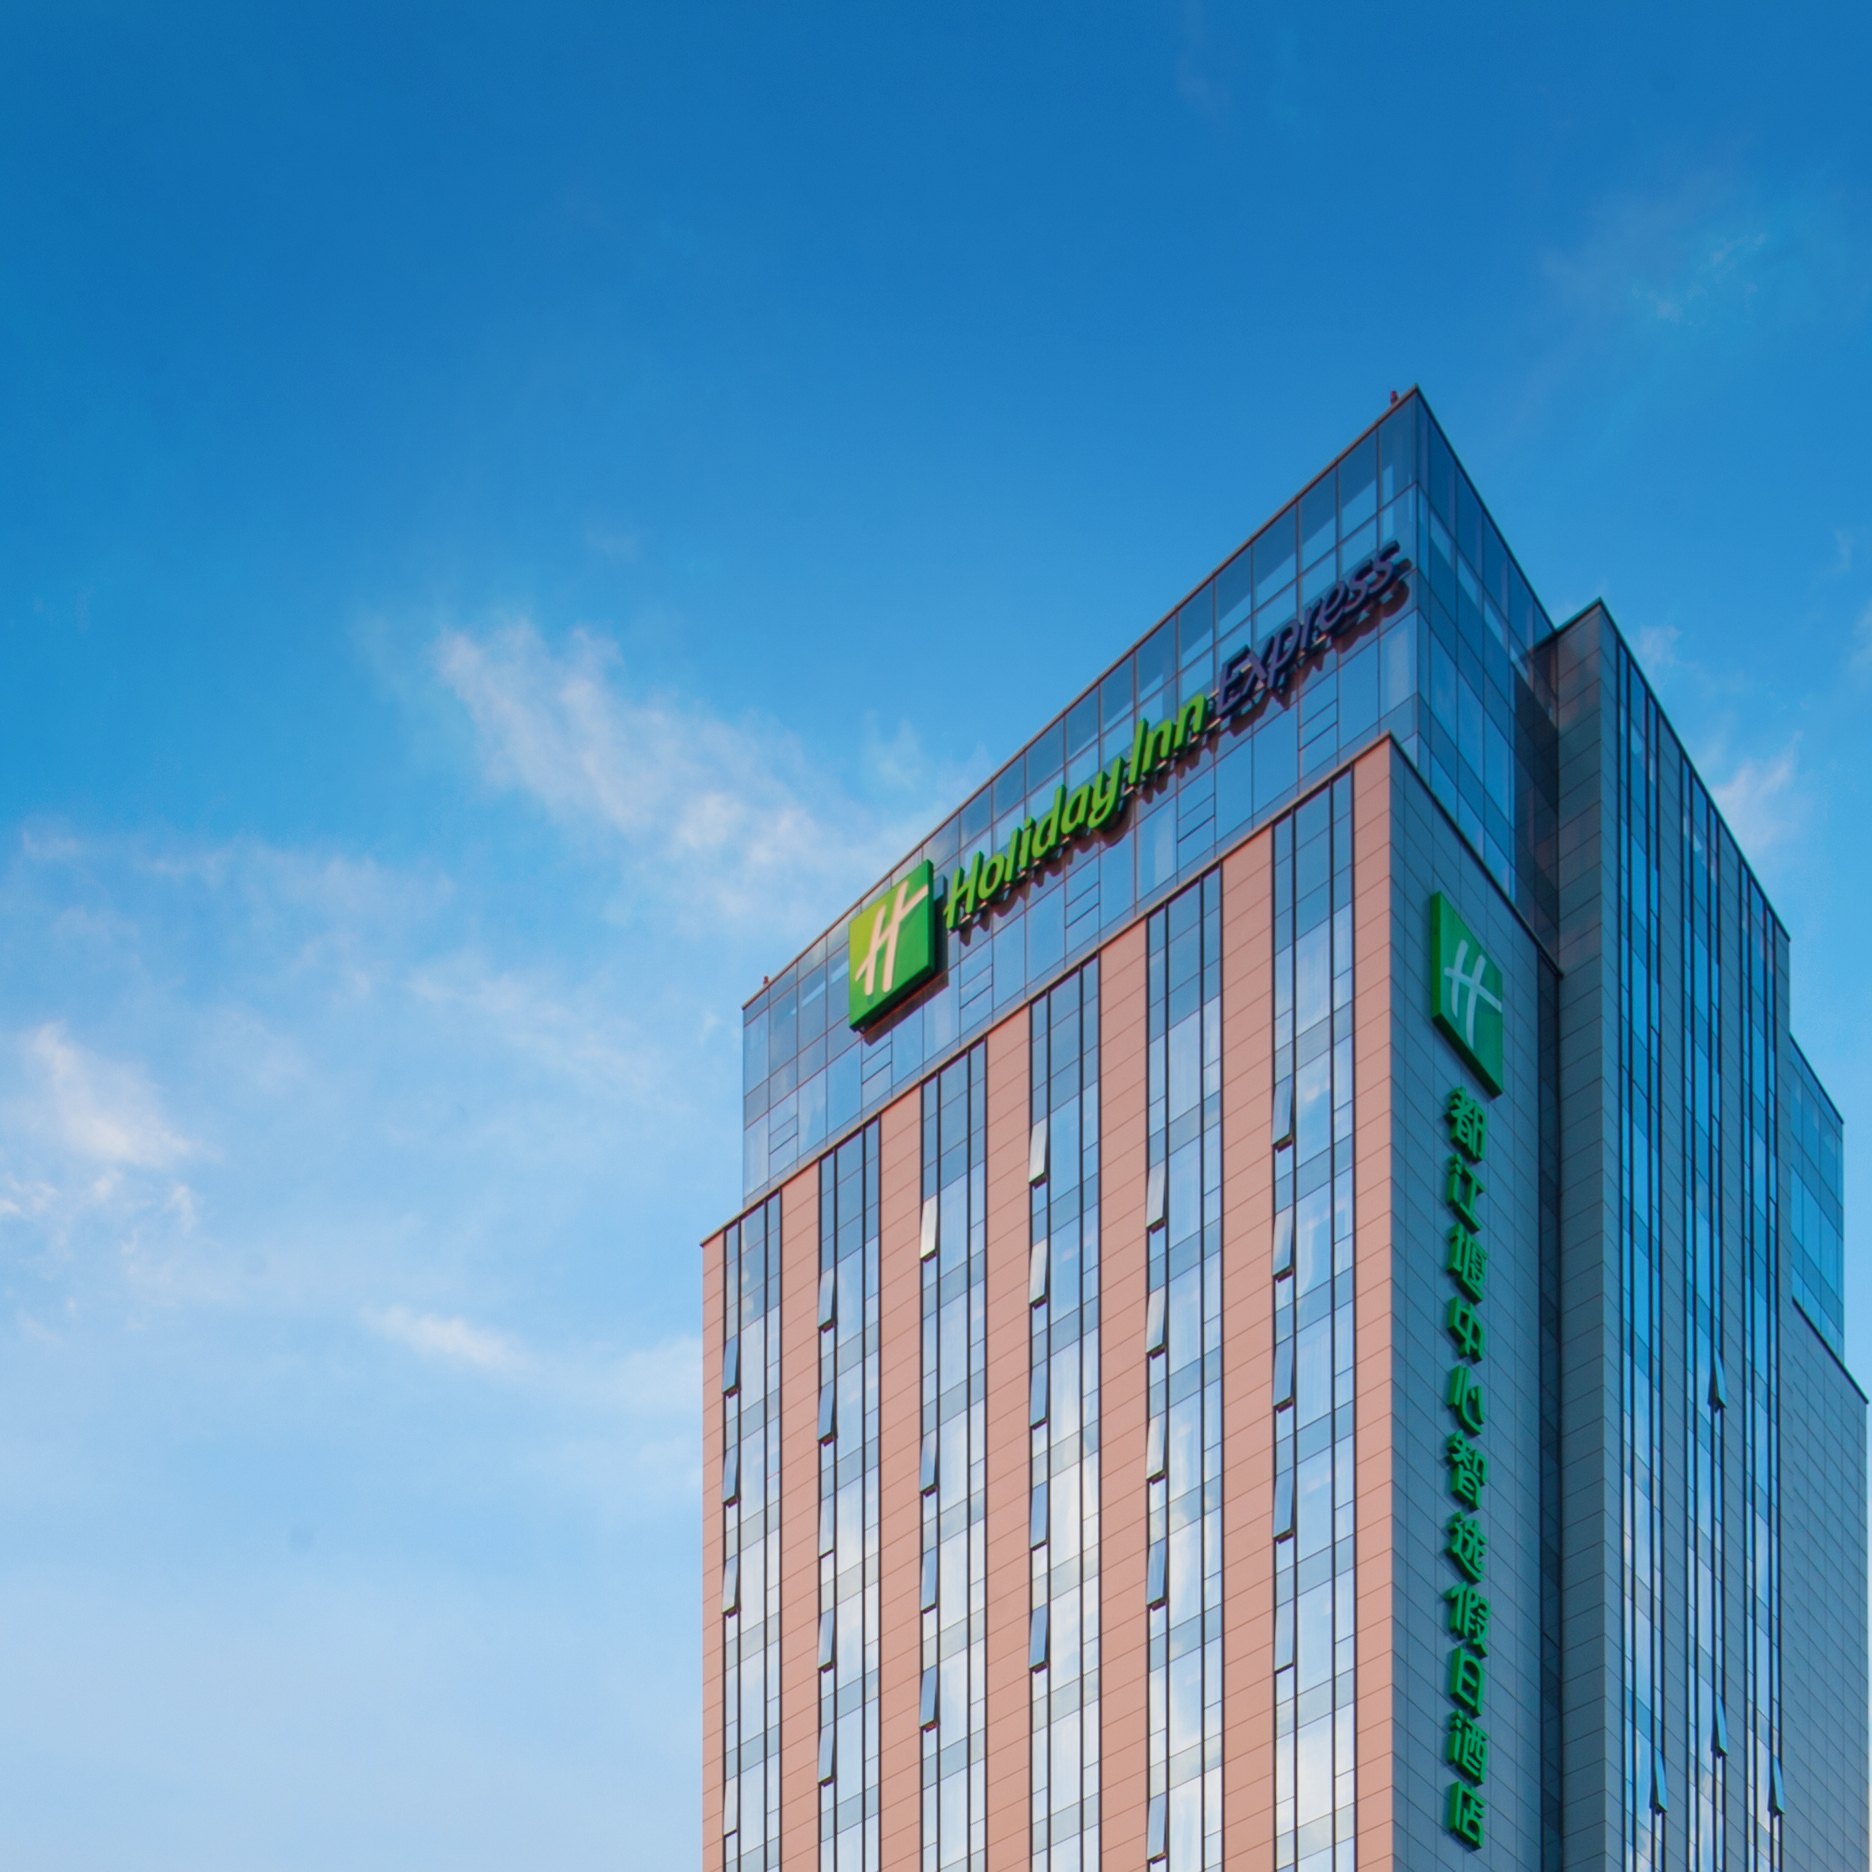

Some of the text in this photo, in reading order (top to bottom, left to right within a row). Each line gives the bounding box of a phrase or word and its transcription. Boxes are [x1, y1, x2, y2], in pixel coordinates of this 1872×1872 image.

[944, 541, 1408, 930] Holiday Inn Express
